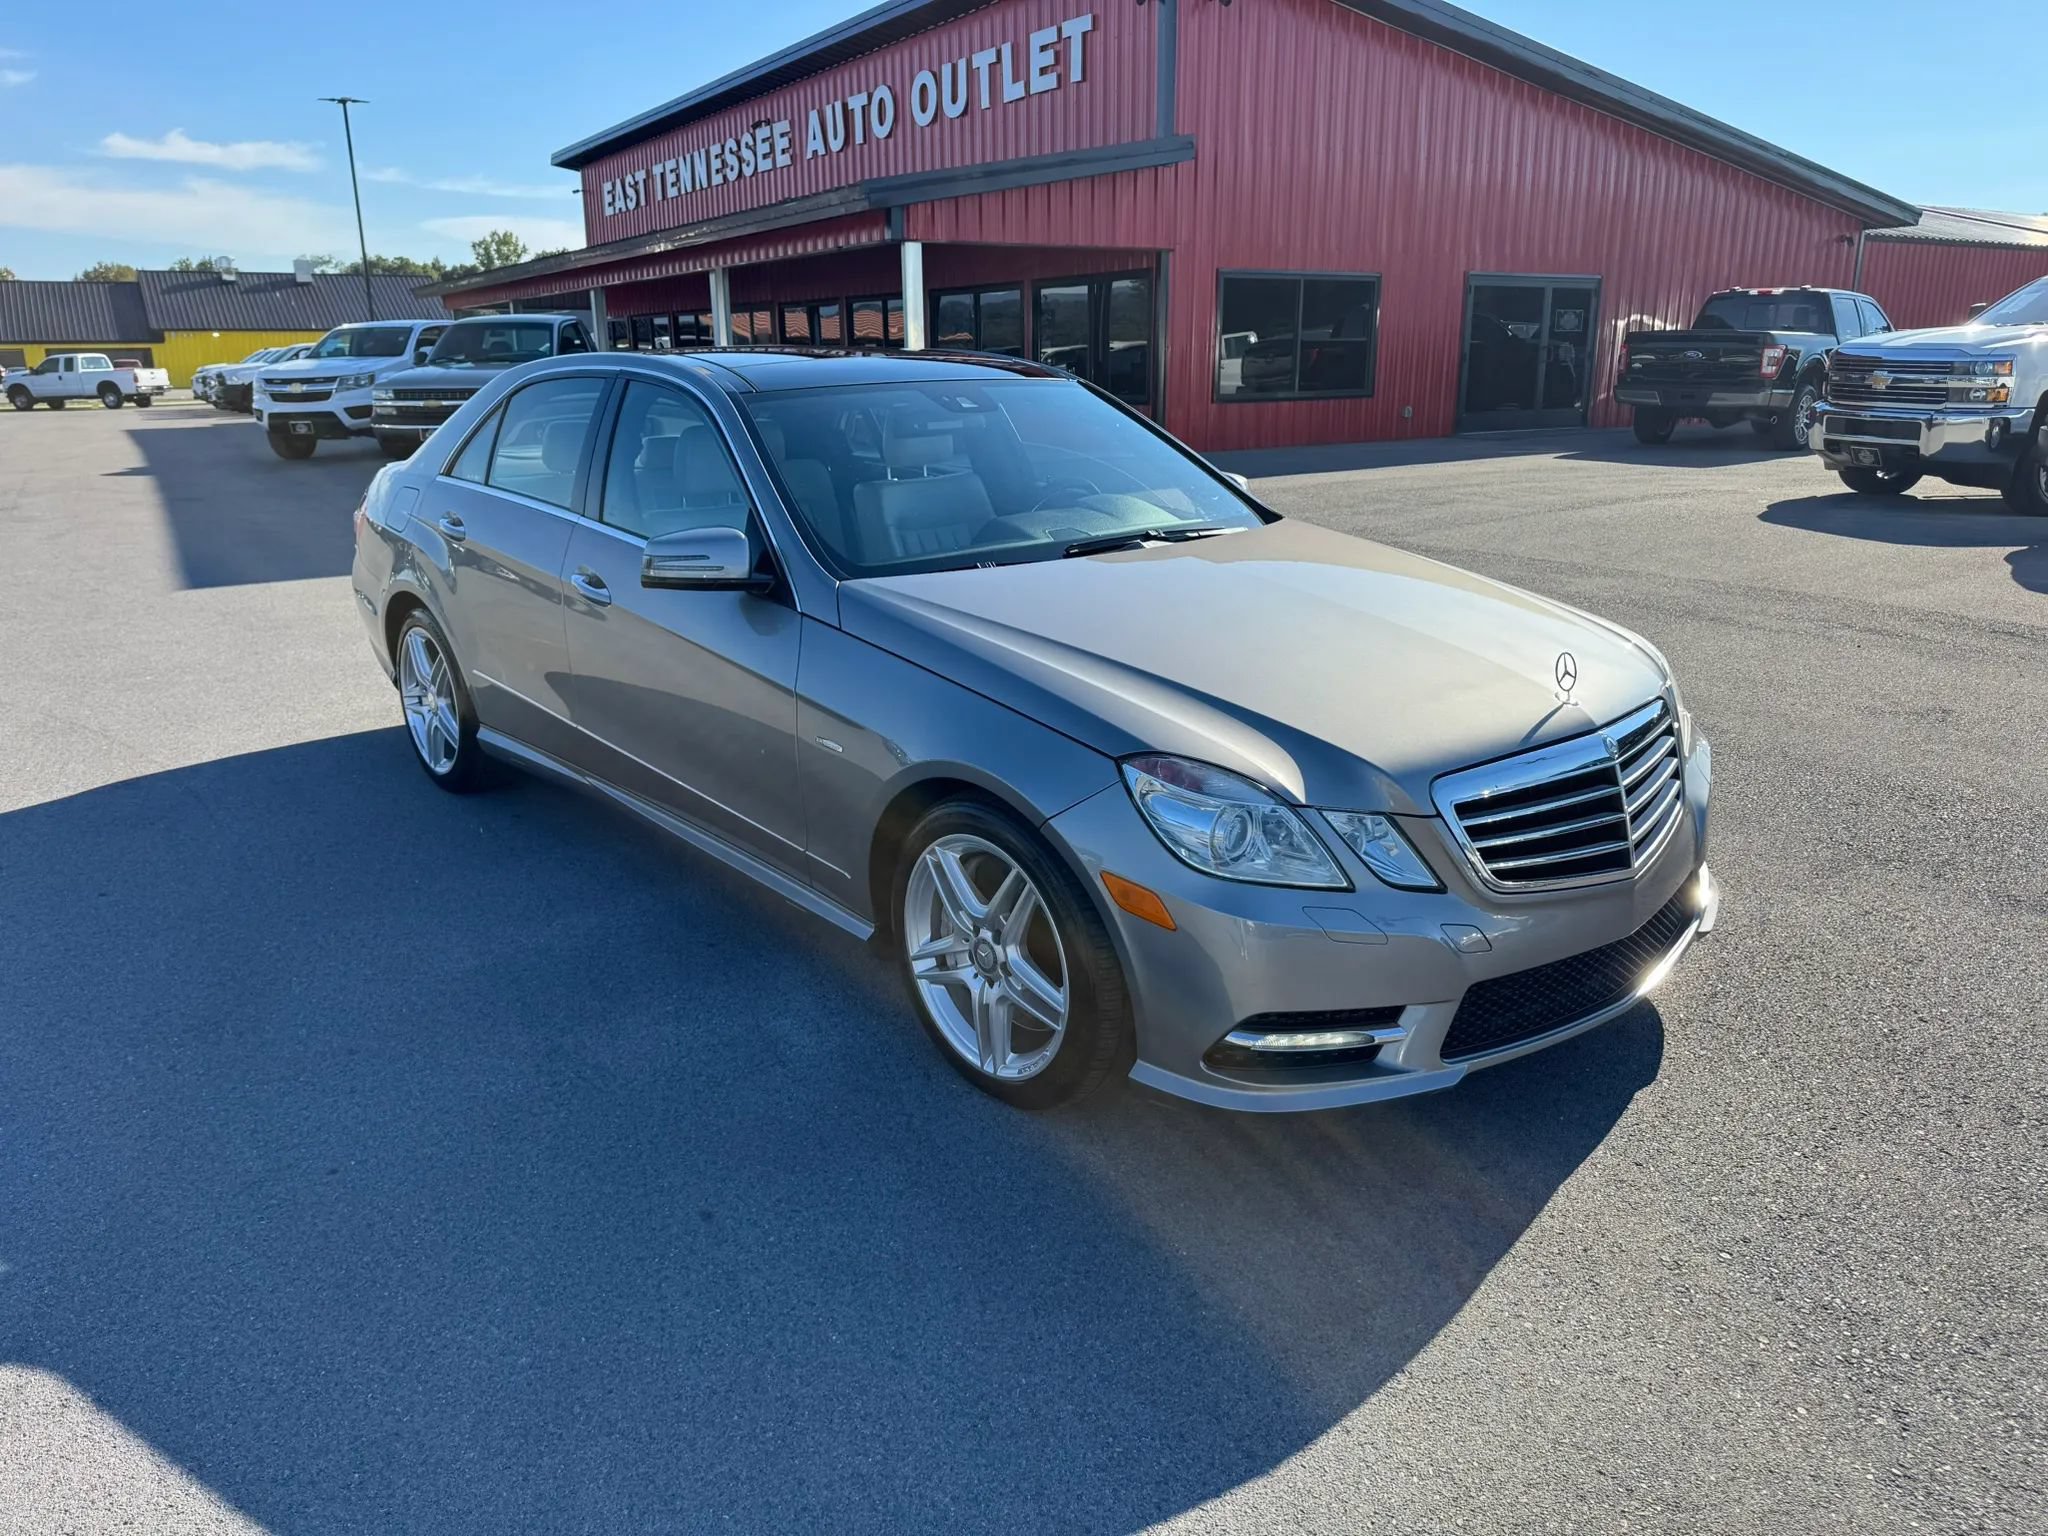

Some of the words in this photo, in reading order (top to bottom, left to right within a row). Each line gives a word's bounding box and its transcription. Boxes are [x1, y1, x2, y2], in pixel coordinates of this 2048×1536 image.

[603, 168, 647, 217] EAST
[652, 119, 793, 201] TENNESSEE
[805, 84, 895, 160] AUTO
[910, 13, 1094, 128] OUTLET
